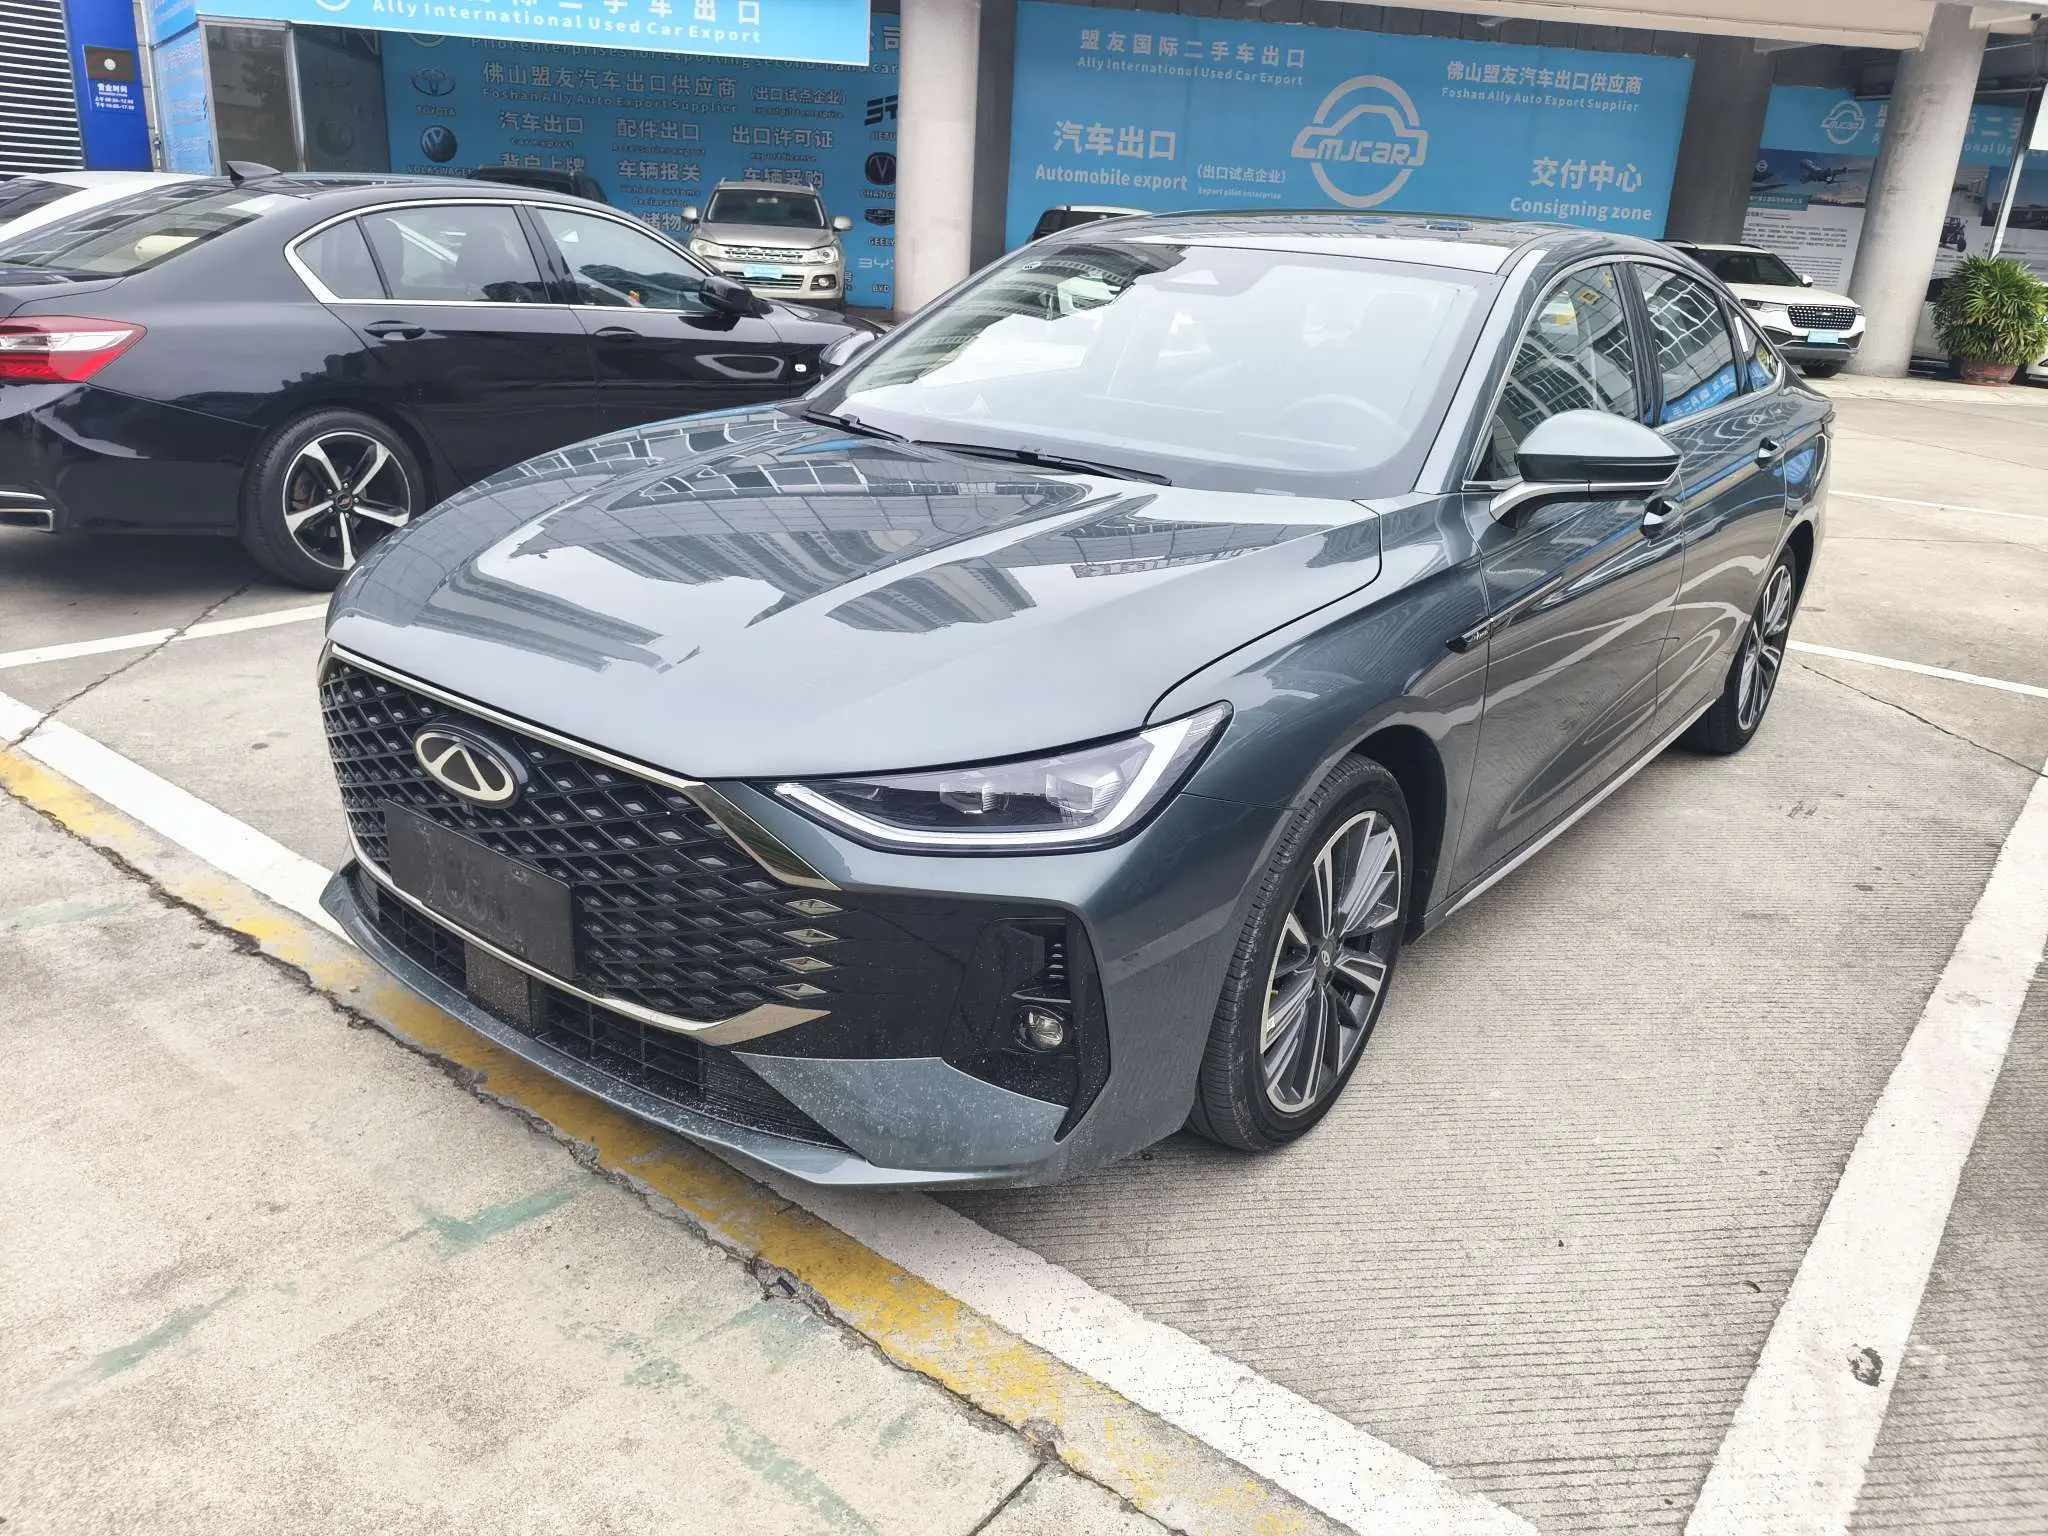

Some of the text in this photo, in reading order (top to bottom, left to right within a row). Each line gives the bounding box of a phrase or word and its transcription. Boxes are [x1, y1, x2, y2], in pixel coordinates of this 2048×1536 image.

[372, 0, 761, 44] Ally International Used Car Export
[1079, 29, 1305, 69] 盟友国际二手车出口
[483, 62, 738, 98] 佛山盟友汽车出口供应商
[1077, 56, 1303, 86] Ally International Used Car Export
[1447, 61, 1643, 96] 佛山盟友汽车出口供应商
[482, 88, 737, 114] Foshan Ally Auto Export Supplier
[1442, 87, 1640, 112] Foshan Ally Auto Export Supplier
[500, 112, 584, 134] 汽车出口
[616, 118, 700, 141] 配件出口
[732, 125, 833, 148] 出口许可证
[1054, 119, 1176, 161] 汽车出口
[618, 159, 700, 182] 车辆报关
[1035, 163, 1189, 193] Automobile export
[1530, 157, 1643, 193] 交付中心
[1510, 197, 1653, 222] Consigning zone
